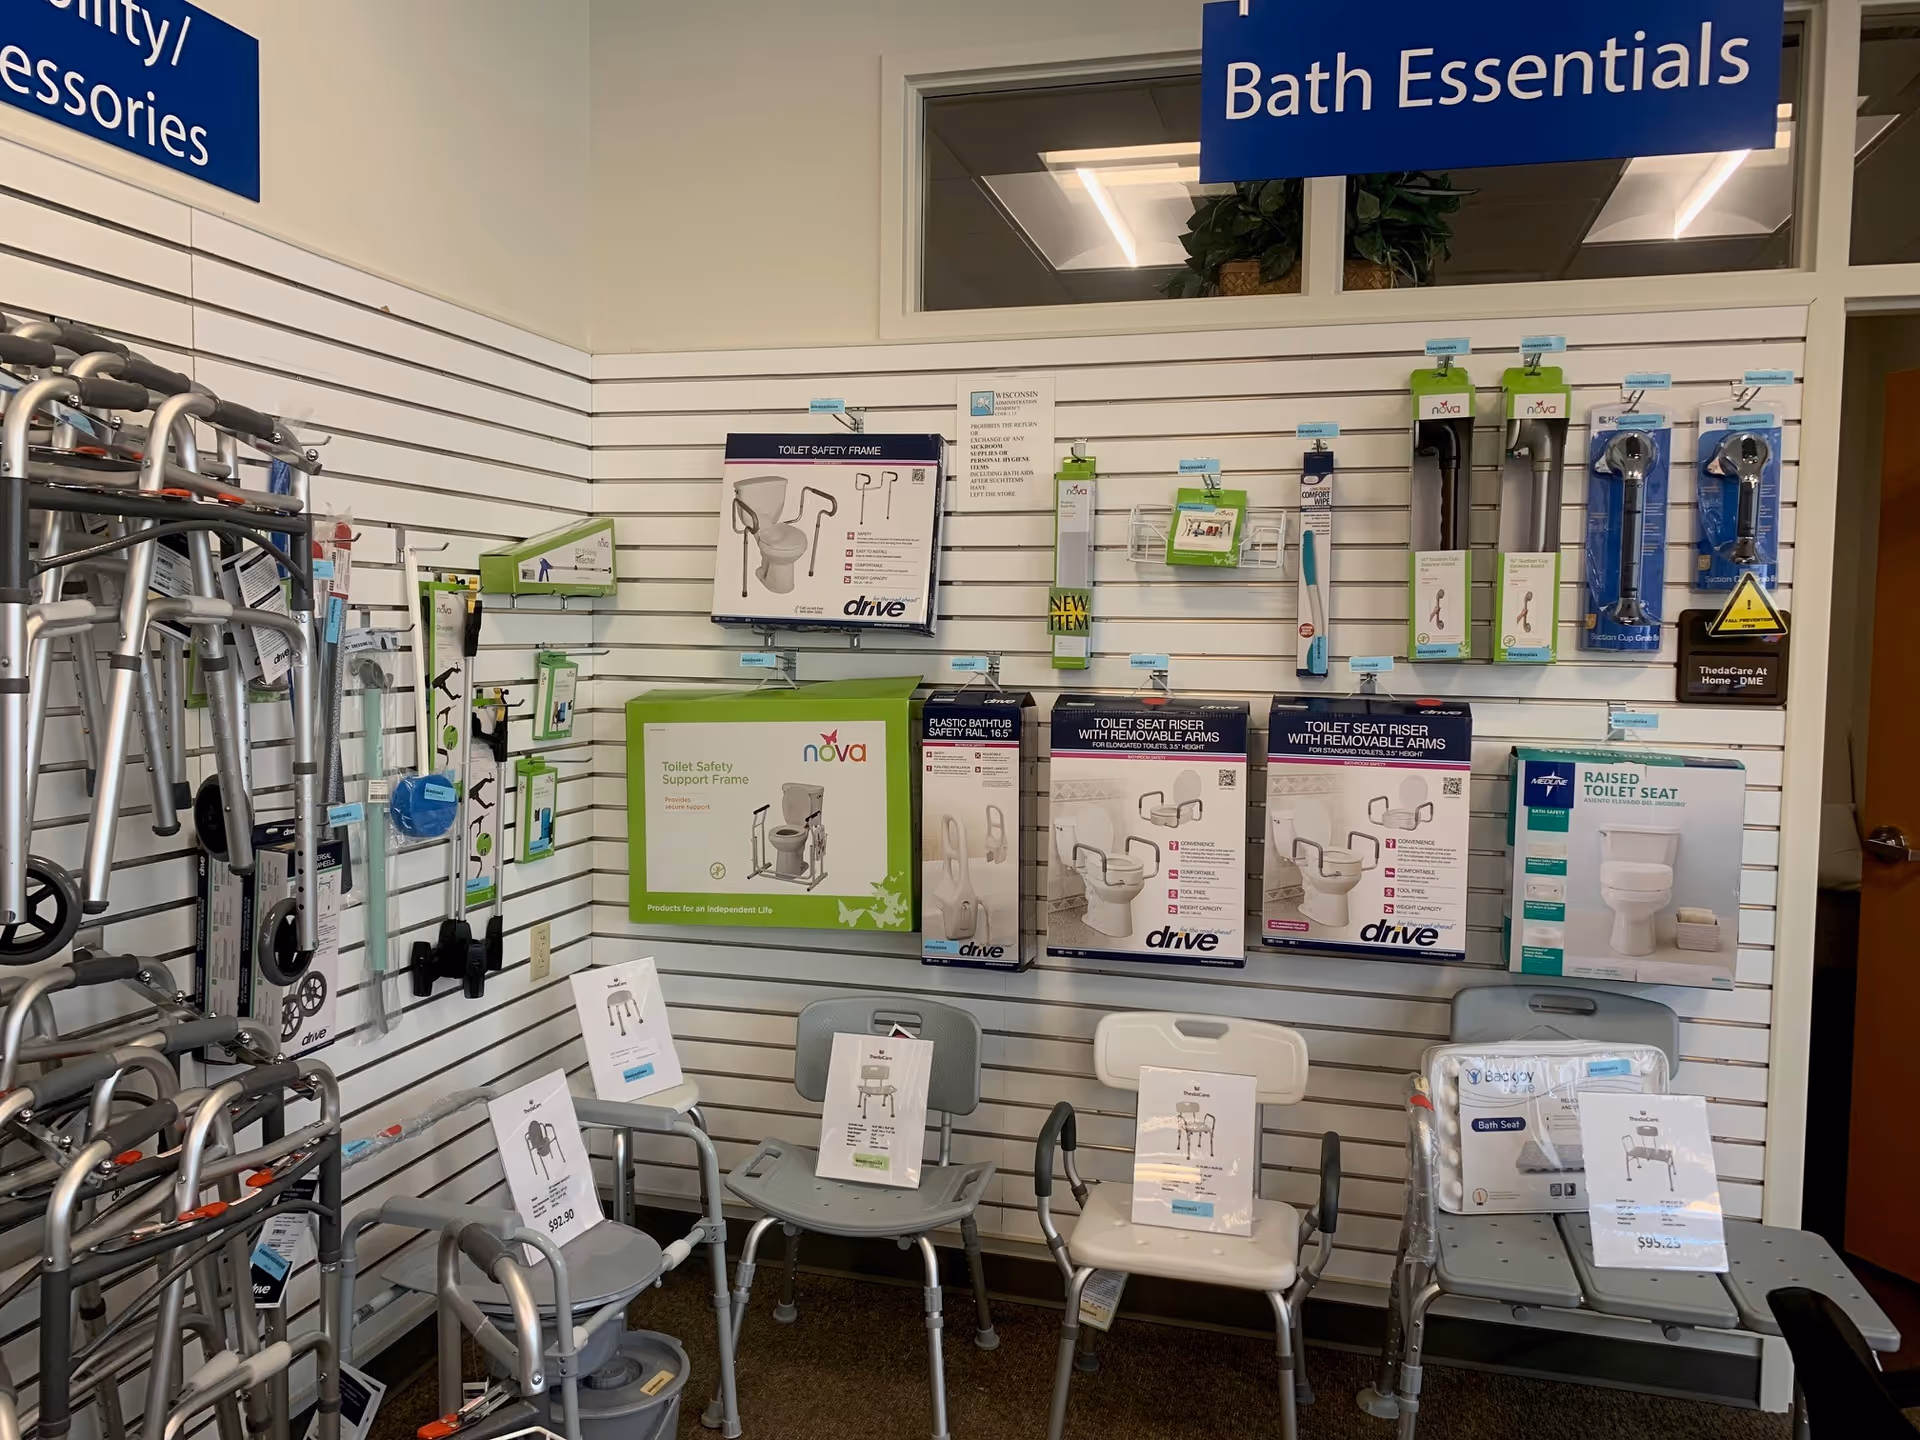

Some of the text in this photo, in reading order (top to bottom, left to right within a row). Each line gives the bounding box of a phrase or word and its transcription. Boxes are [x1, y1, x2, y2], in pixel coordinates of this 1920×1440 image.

[1225, 21, 1750, 120] Bath Essentials
[995, 391, 1038, 399] WISCONSIN
[1432, 405, 1460, 414] nova
[1527, 405, 1556, 414] nova
[778, 446, 882, 455] TOILET SAFETY FRAME
[1302, 490, 1330, 498] COMFORT
[1314, 498, 1330, 506] WIPE
[843, 595, 906, 617] drive
[1050, 594, 1089, 612] NEW
[1050, 614, 1089, 631] ITEM
[1591, 633, 1652, 642] Suction Cup Grab
[273, 648, 290, 664] drive
[1699, 666, 1768, 676] ThedaCare At
[1702, 676, 1731, 685] Home
[1740, 676, 1764, 686] DME
[930, 718, 1012, 728] PLASTIC BATHTUB
[1094, 718, 1204, 730] TOILET SEAT RISER
[1305, 721, 1428, 736] TOILET SEAT RISER
[929, 728, 1012, 738] SAFETY RAIL, 16.5"
[1079, 729, 1220, 742] WITH REMOVABLE ARMS
[1106, 742, 1142, 750] ELONGATED
[1142, 742, 1169, 750] TOILETS,
[1288, 733, 1446, 750] WITH REMOVABLE ARMS
[804, 744, 867, 763] nova
[1358, 748, 1386, 757] TOILETS,
[662, 761, 733, 774] Toilet Safety
[662, 774, 750, 786] Support Frame
[1531, 778, 1568, 786] MEDLINE
[1584, 772, 1640, 784] RAISED
[1584, 784, 1678, 800] TOILET SEAT
[1612, 798, 1640, 806] ELEVADO
[647, 904, 681, 913] Products
[682, 904, 694, 913] for
[706, 905, 756, 914] Independent
[758, 906, 773, 914] Life
[1360, 919, 1439, 946] drive
[1146, 926, 1219, 952] drive
[959, 942, 1004, 958] drive
[301, 1028, 327, 1046] drive
[1484, 1070, 1534, 1084] Backjoy
[1183, 1090, 1210, 1098] ThedaCare
[1478, 1120, 1520, 1129] Bath Seat
[548, 1208, 574, 1233] $92.90
